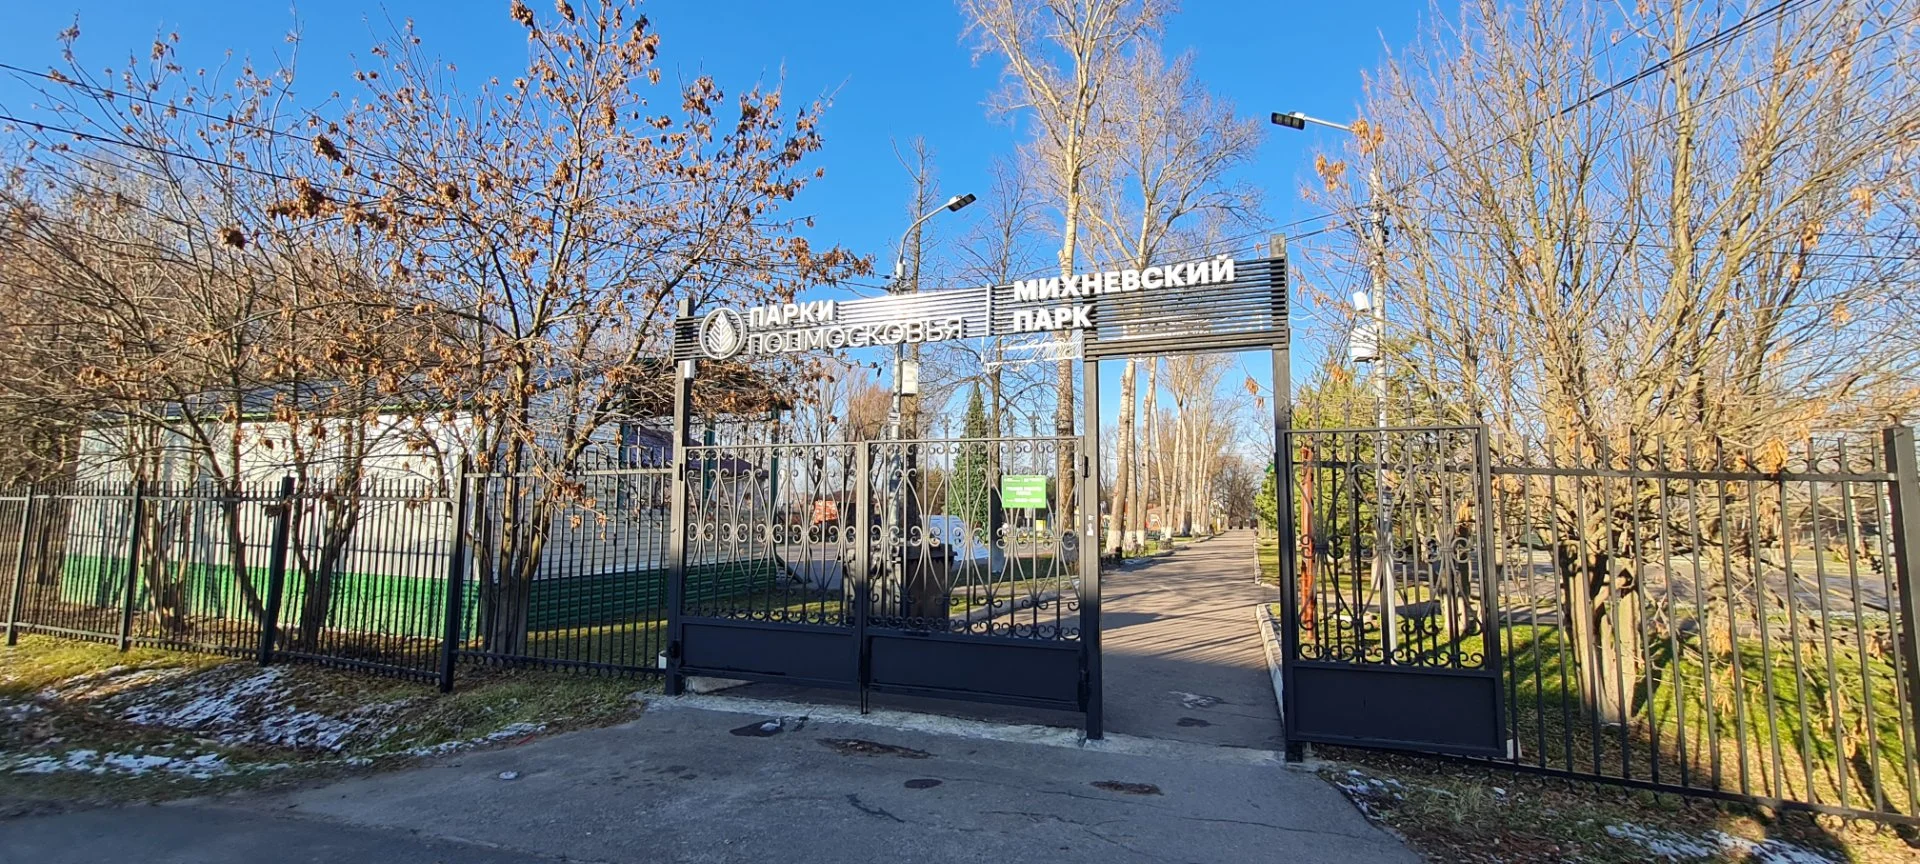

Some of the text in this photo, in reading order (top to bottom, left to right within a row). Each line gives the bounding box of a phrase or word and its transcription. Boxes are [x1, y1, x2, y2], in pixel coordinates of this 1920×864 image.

[1013, 254, 1235, 302] МИХНЕВСКИЙ
[749, 300, 834, 328] ПАРКИ
[1013, 305, 1093, 332] ПАРК
[749, 316, 964, 354] ПОДМОСКОВЬЯ
